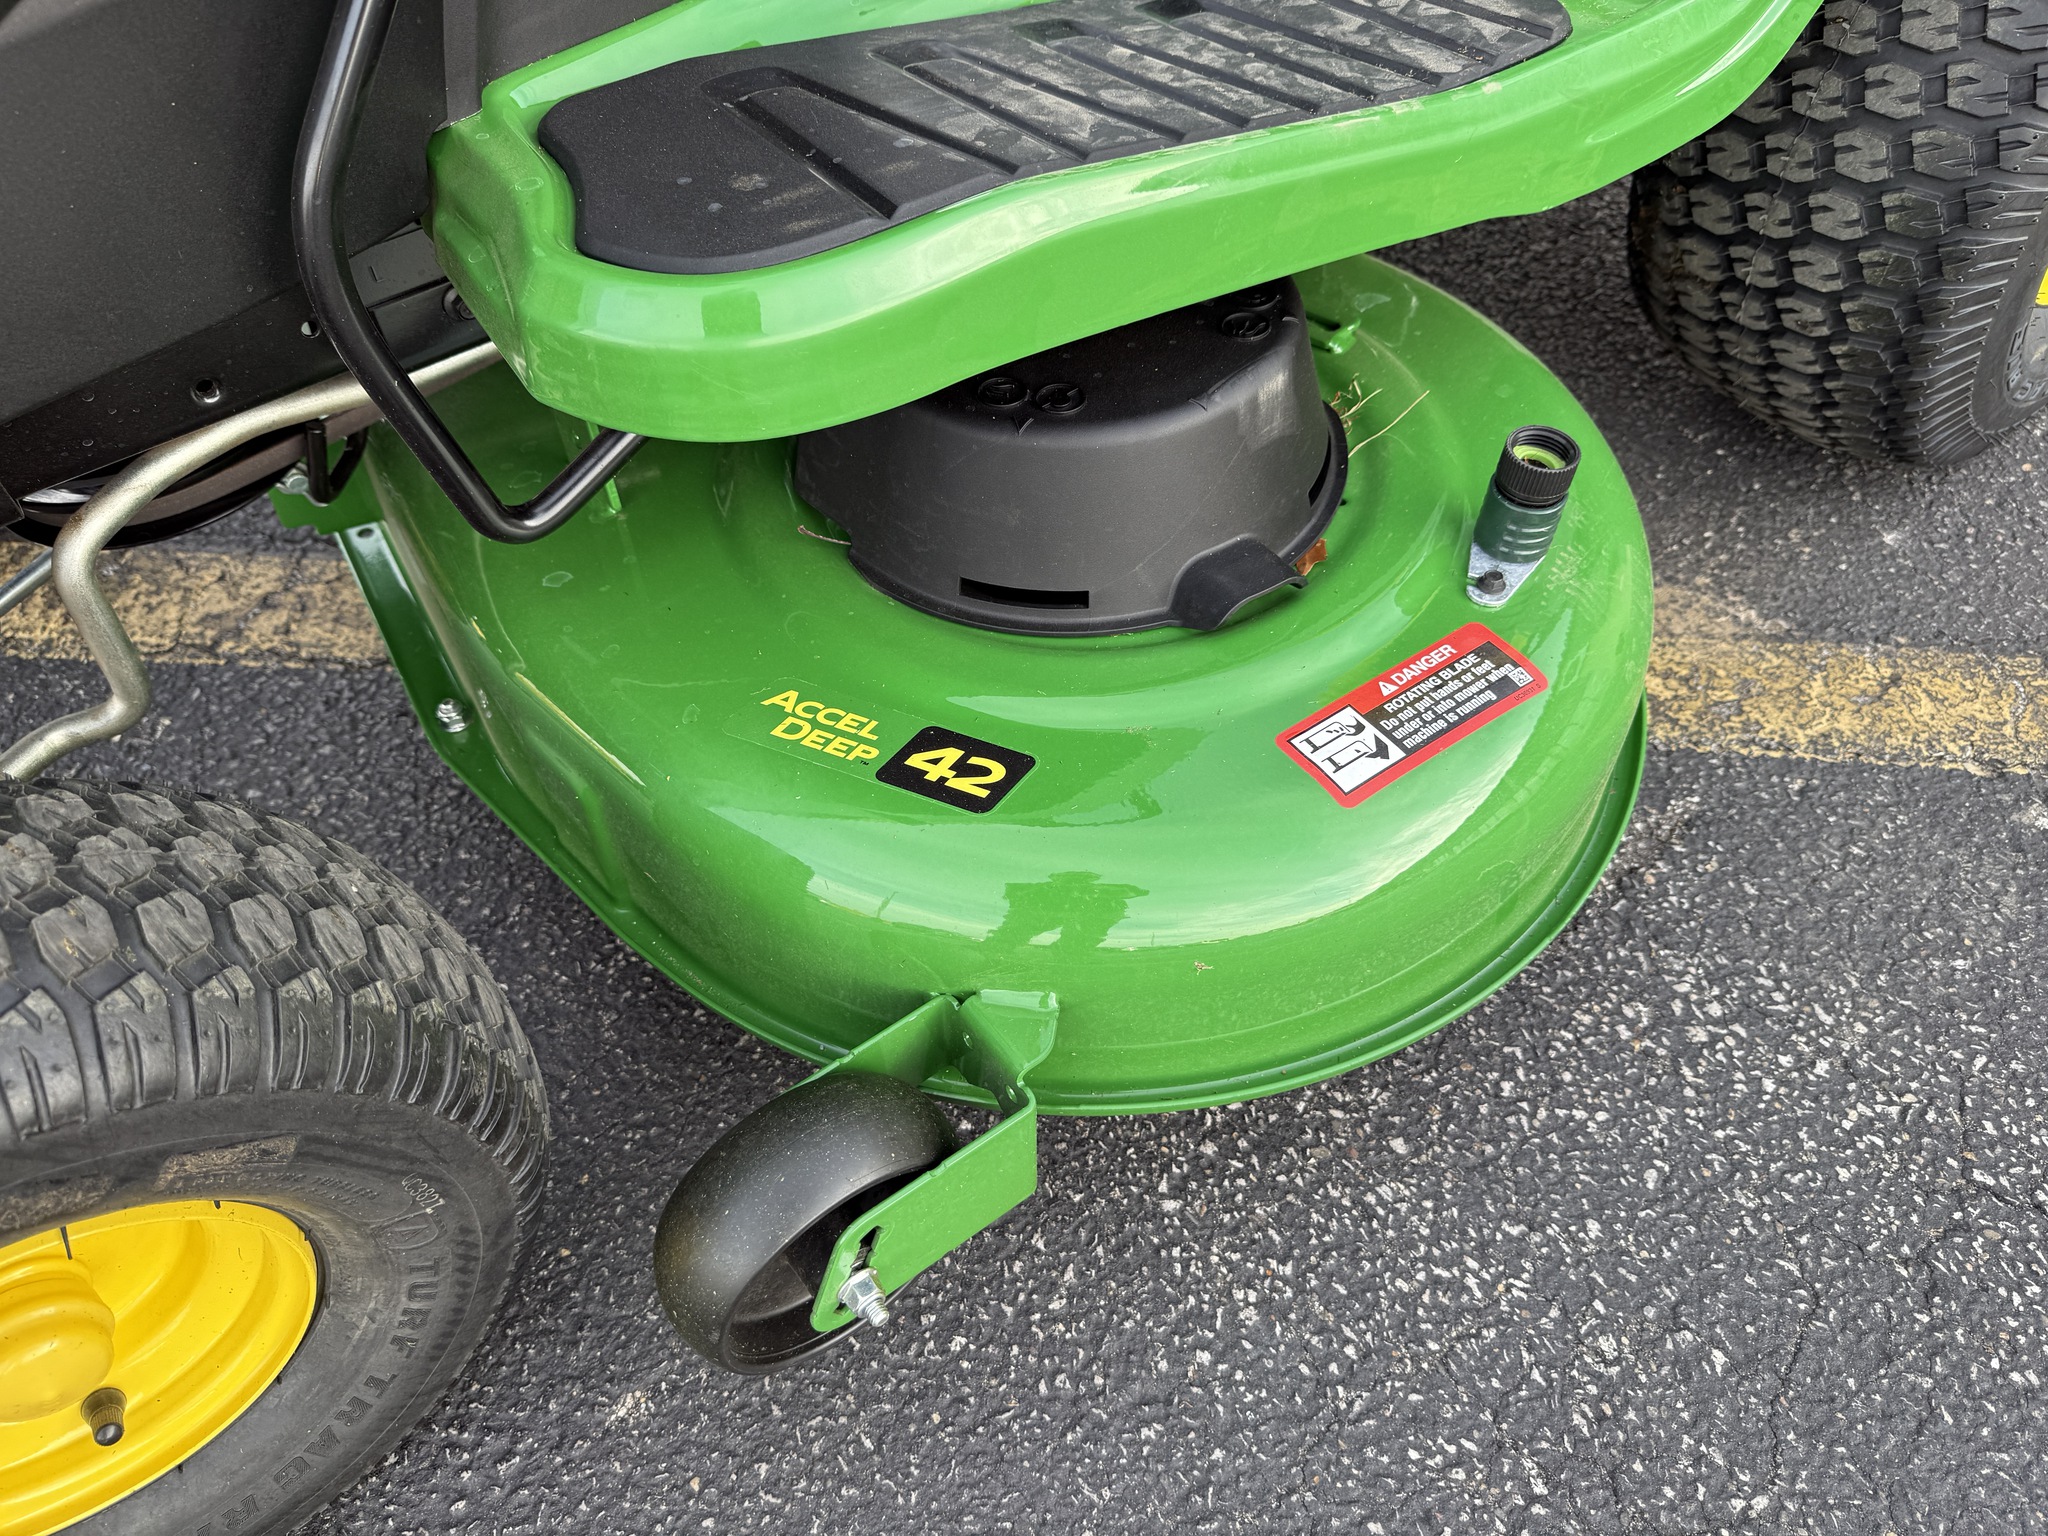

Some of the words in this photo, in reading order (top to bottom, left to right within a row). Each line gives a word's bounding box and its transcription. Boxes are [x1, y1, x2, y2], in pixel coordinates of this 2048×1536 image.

[1379, 716, 1399, 731] Do
[1398, 705, 1418, 721] not
[1414, 696, 1435, 712] put
[1429, 680, 1464, 705] hands
[1461, 672, 1475, 683] or
[1470, 659, 1496, 676] feet
[1383, 677, 1442, 713] ROTATING
[1438, 653, 1482, 680] BLADE
[1390, 644, 1458, 686] DANGER
[760, 689, 879, 740] ACCEL
[1391, 717, 1424, 740] under
[1421, 710, 1435, 722] or
[1431, 698, 1456, 715] into
[1453, 681, 1490, 703] mower
[1485, 663, 1515, 683] when
[1402, 719, 1448, 749] machine
[1445, 712, 1459, 723] is
[1455, 689, 1497, 717] running
[770, 715, 880, 761] DEEP
[904, 747, 1007, 798] 42
[390, 1256, 440, 1359] TURF
[273, 1373, 398, 1490] TRAC
